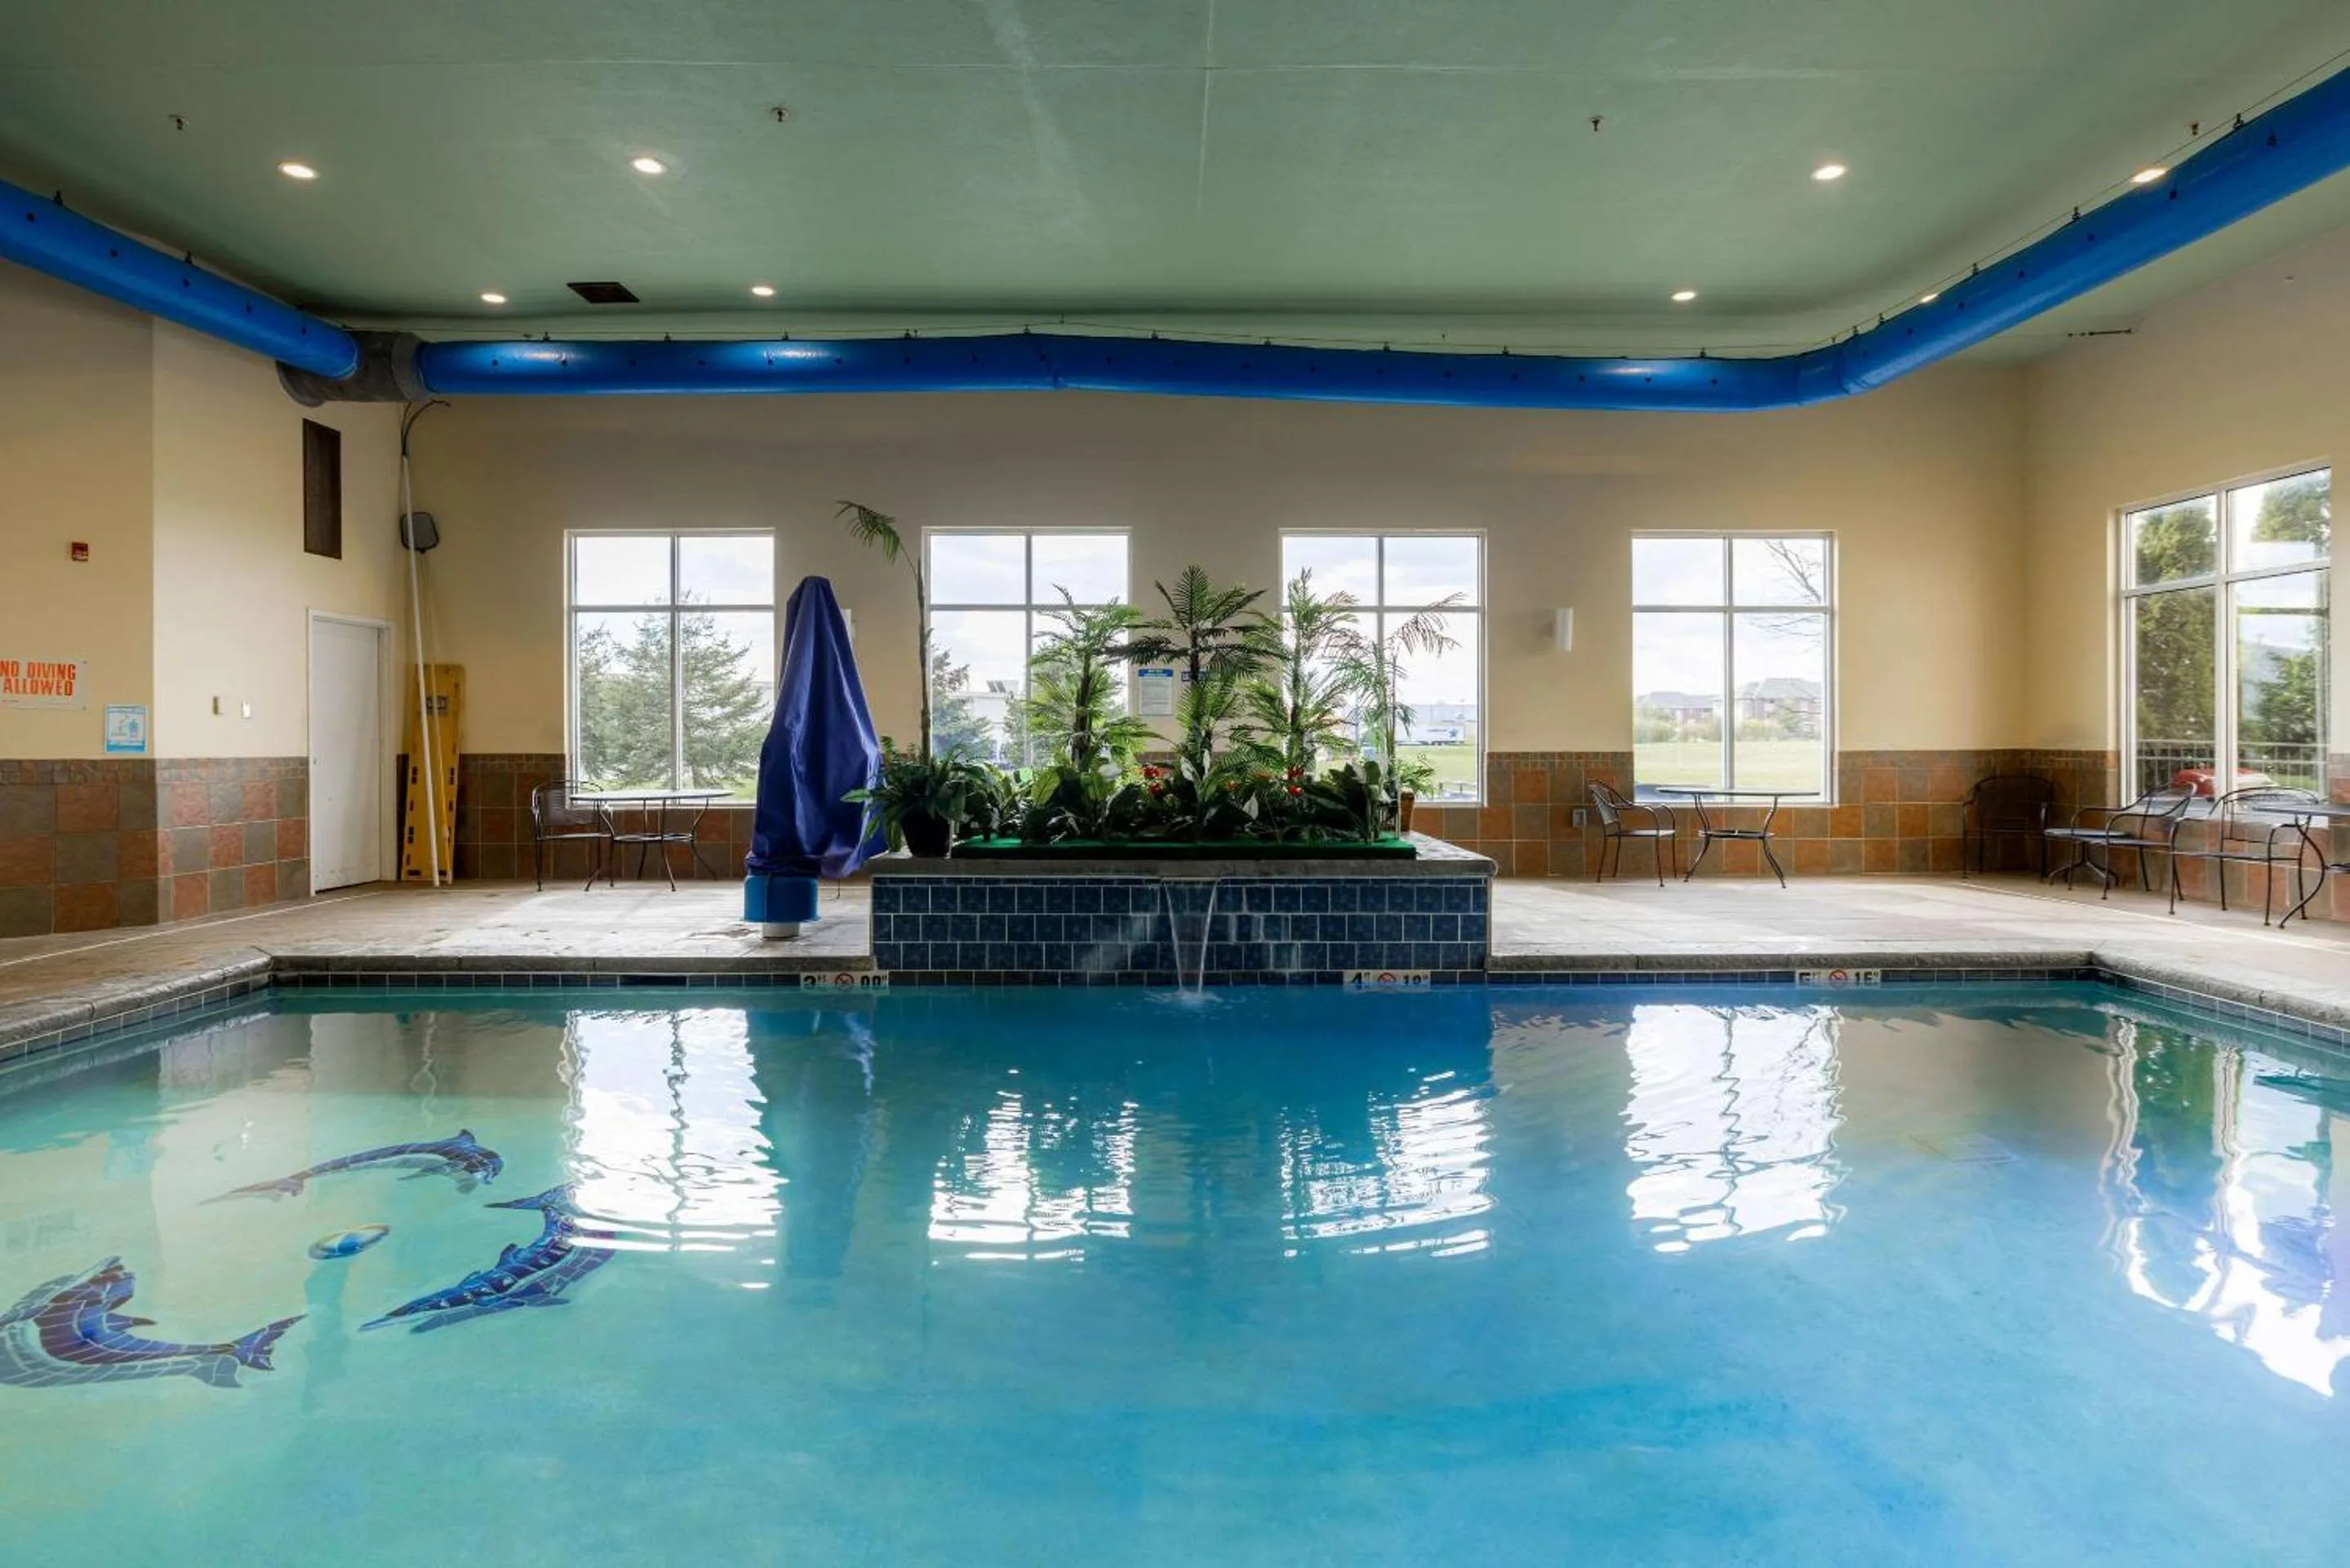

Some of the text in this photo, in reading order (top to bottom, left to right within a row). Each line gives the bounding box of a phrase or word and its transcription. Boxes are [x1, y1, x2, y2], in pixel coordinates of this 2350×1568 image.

[0, 660, 76, 680] NO DIVING
[3, 678, 73, 695] ALLOWED
